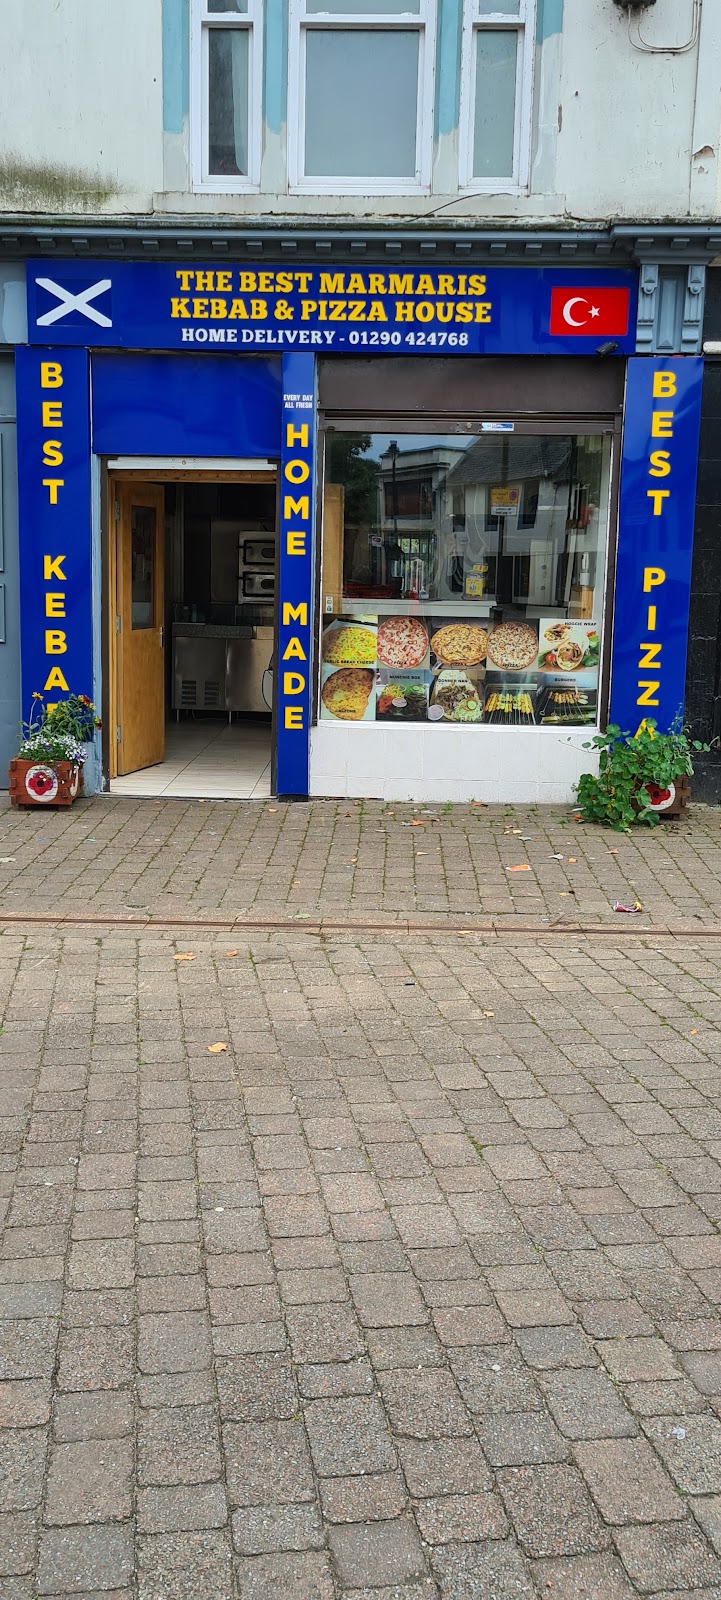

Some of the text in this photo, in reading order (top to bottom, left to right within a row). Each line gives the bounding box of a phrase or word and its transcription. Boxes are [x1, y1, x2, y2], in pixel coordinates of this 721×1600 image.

[170, 298, 492, 324] KEBAB & PIZZA HOUSE
[176, 270, 487, 296] THE BEST MARMARIS
[181, 328, 238, 343] HOME
[241, 329, 336, 345] DELIVERY
[349, 331, 402, 345] 01290
[405, 332, 469, 346] 424768
[40, 362, 65, 505] BEST
[646, 371, 678, 516] BEST
[282, 423, 310, 730] HOME MADE
